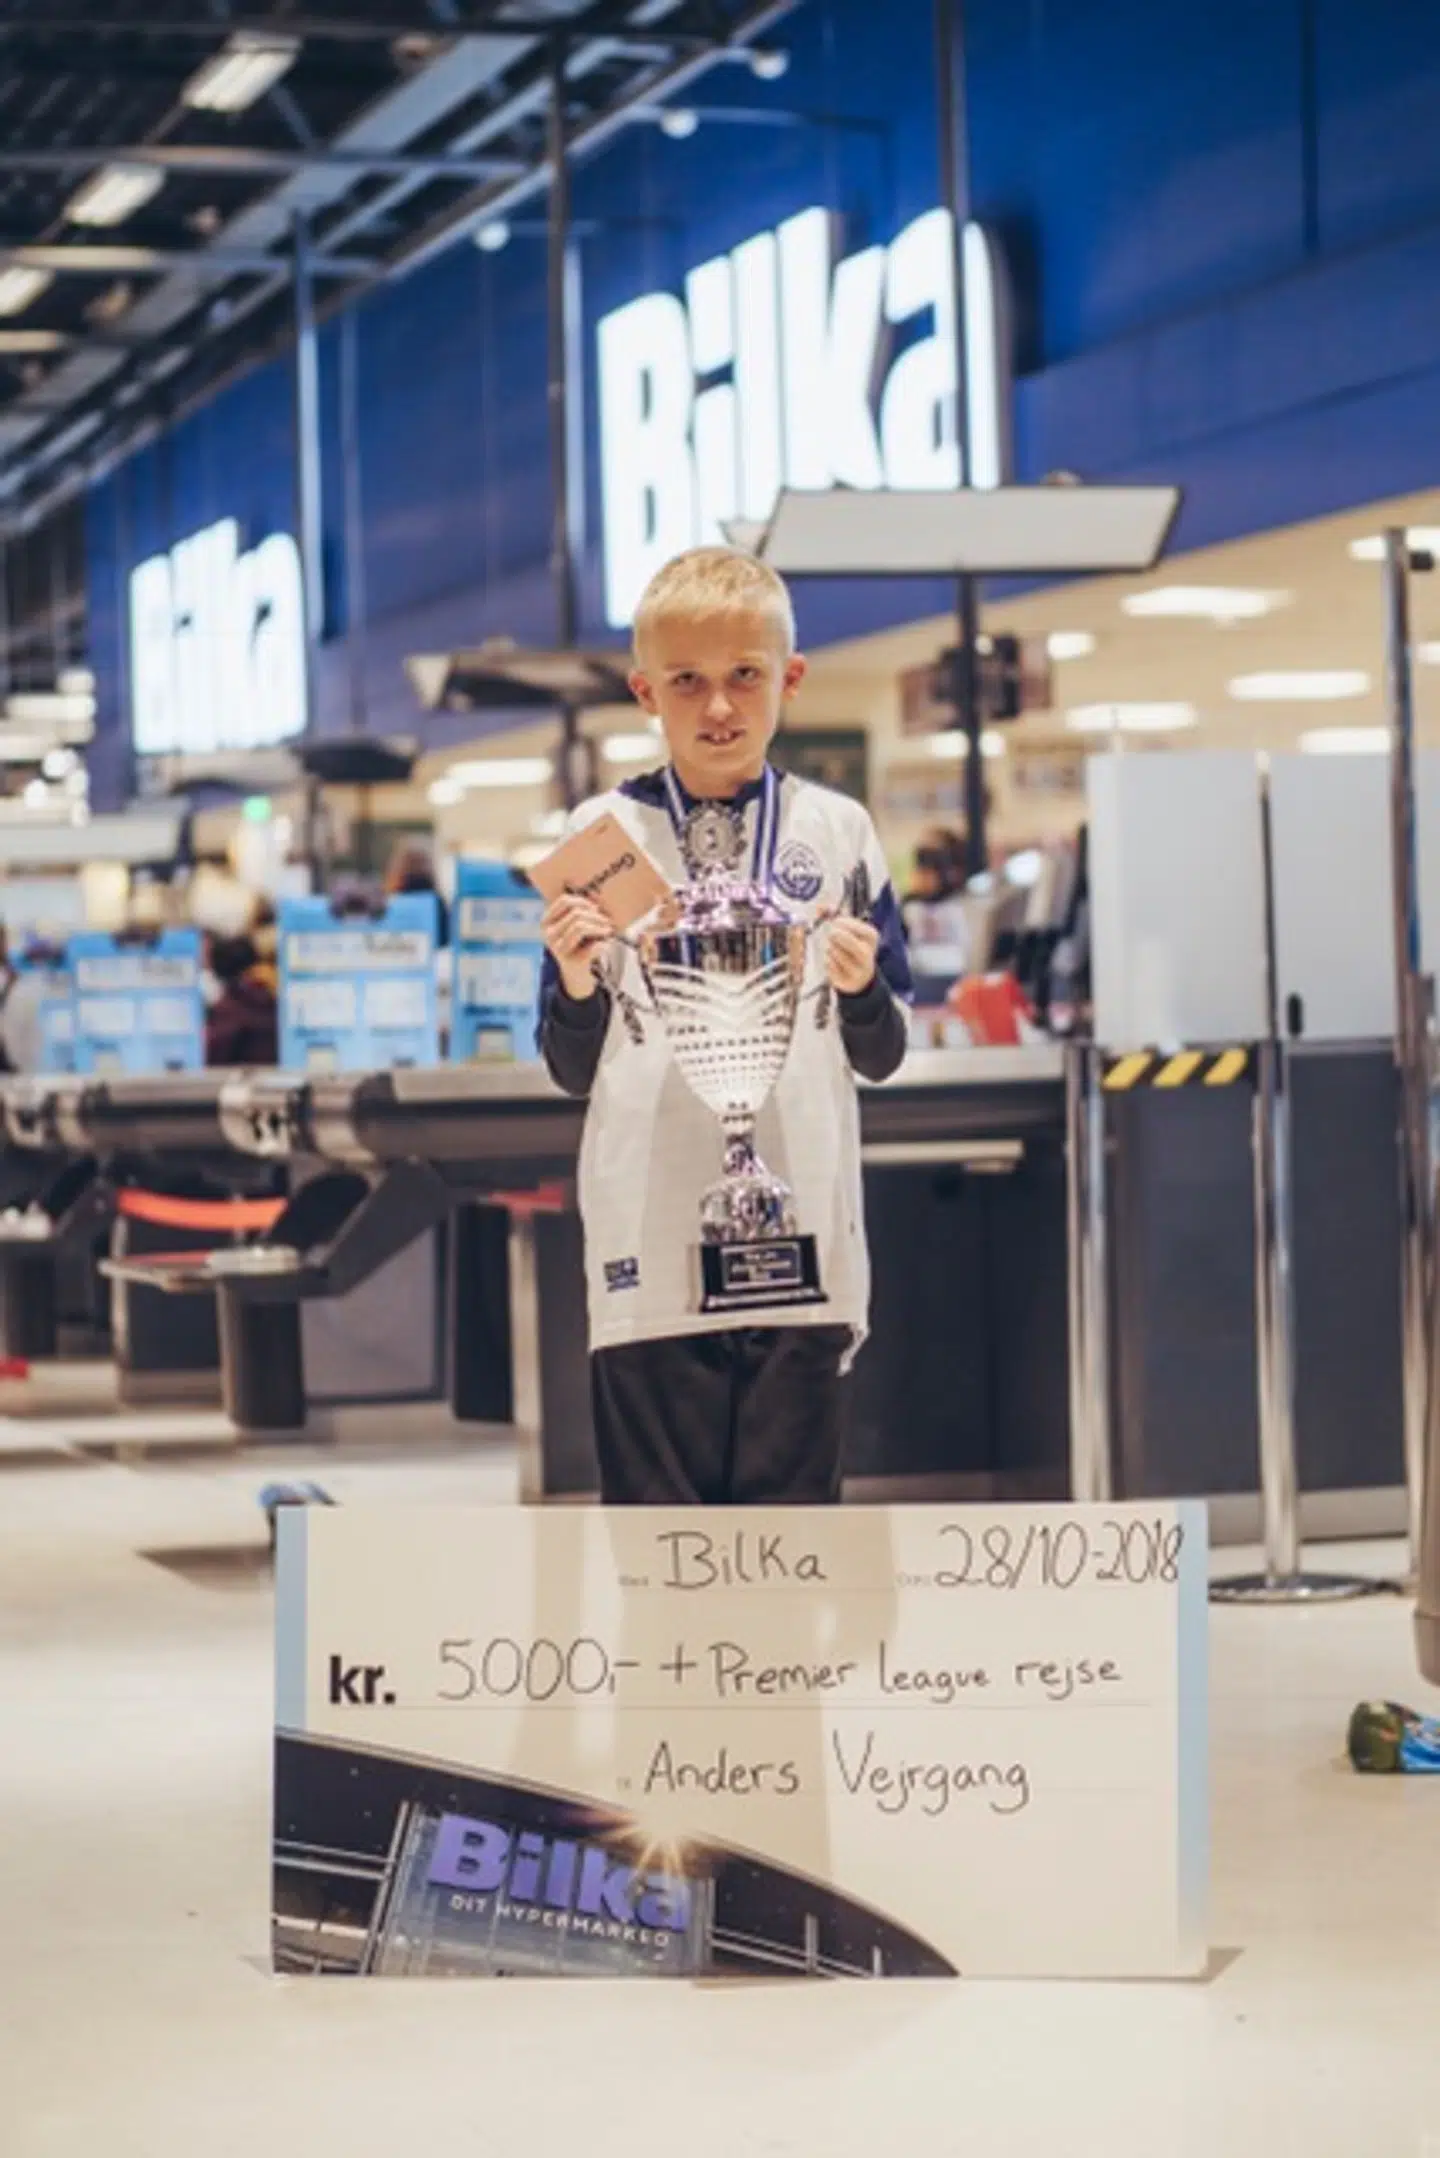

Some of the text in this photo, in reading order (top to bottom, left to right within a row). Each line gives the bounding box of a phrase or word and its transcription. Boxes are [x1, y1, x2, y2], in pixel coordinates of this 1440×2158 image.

[597, 205, 1002, 629] Bilka
[329, 1654, 397, 1704] kr.
[707, 1640, 858, 1696] Premier
[877, 1640, 992, 1704] league
[1014, 1655, 1122, 1701] rejse
[643, 1728, 1031, 1816] Anders Vejrgang
[426, 1812, 692, 1933] Bilka
[450, 1894, 487, 1913] DIT
